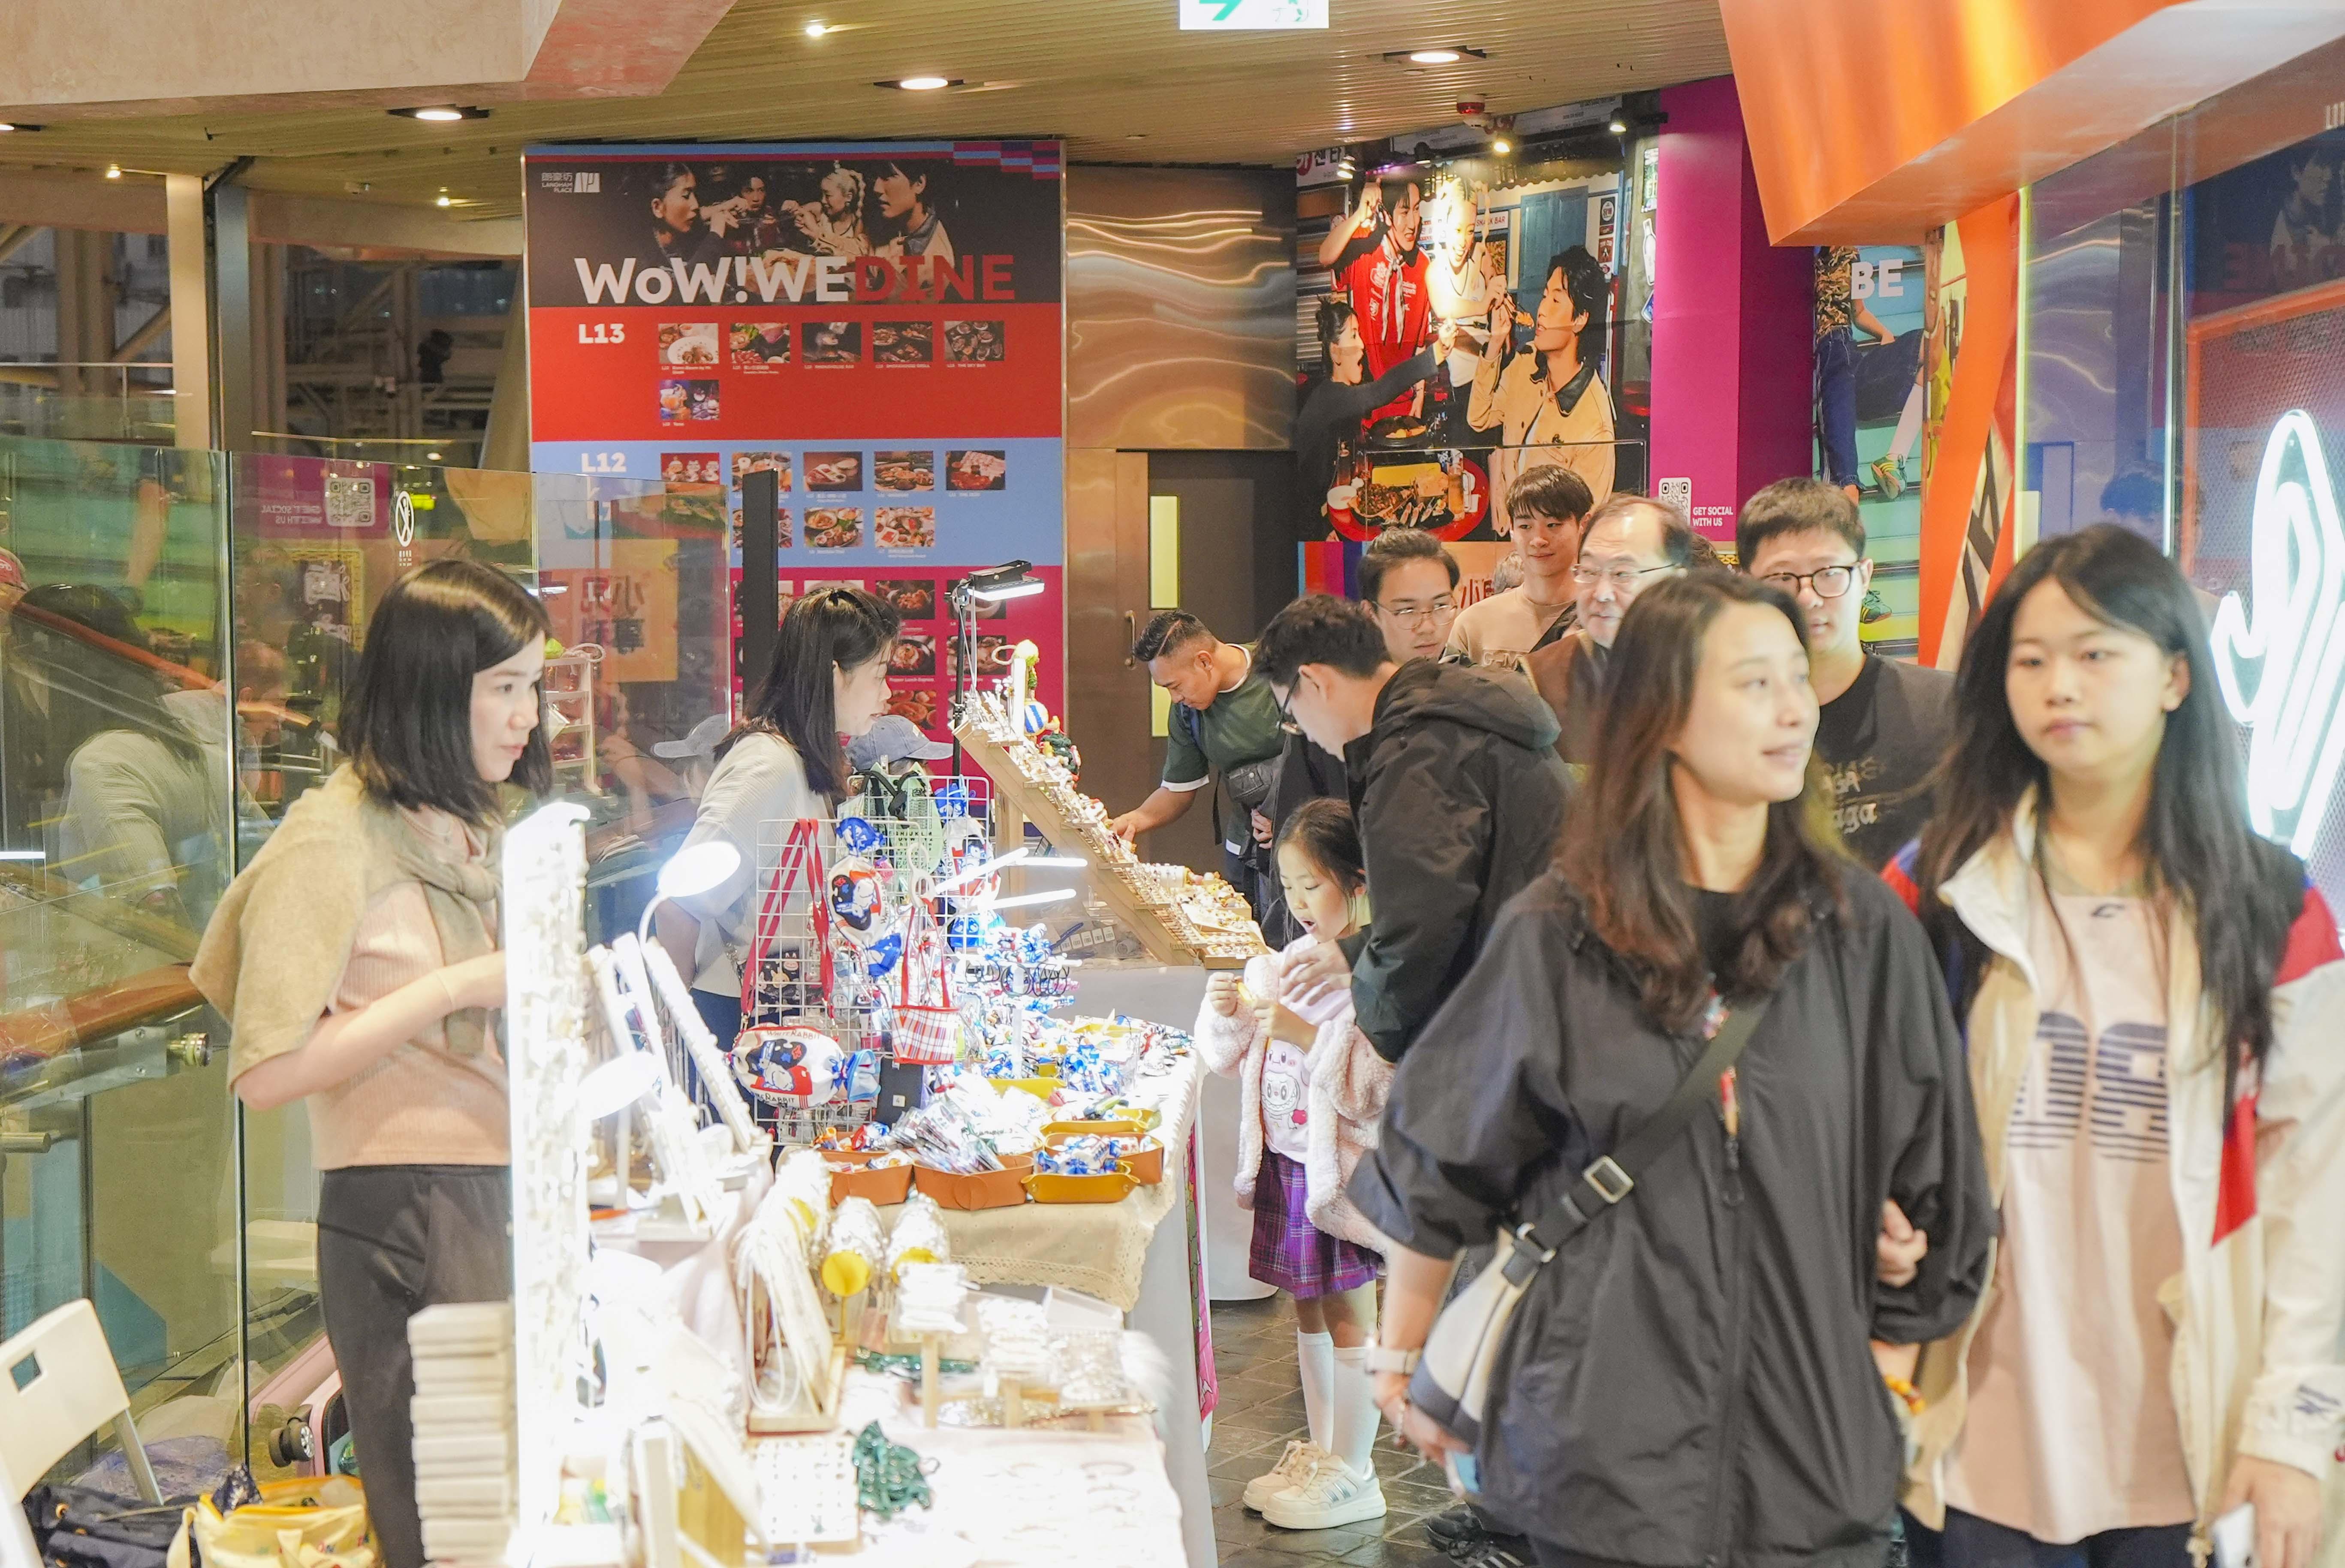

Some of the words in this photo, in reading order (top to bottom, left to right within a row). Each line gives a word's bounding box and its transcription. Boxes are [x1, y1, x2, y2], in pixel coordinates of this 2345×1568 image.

[1851, 259, 1904, 299] BE
[578, 323, 625, 344] L13
[581, 452, 627, 473] L12
[1692, 517, 1712, 527] WITH
[1713, 517, 1723, 526] US
[1693, 507, 1707, 516] GET
[1708, 507, 1734, 516] SOCIAL
